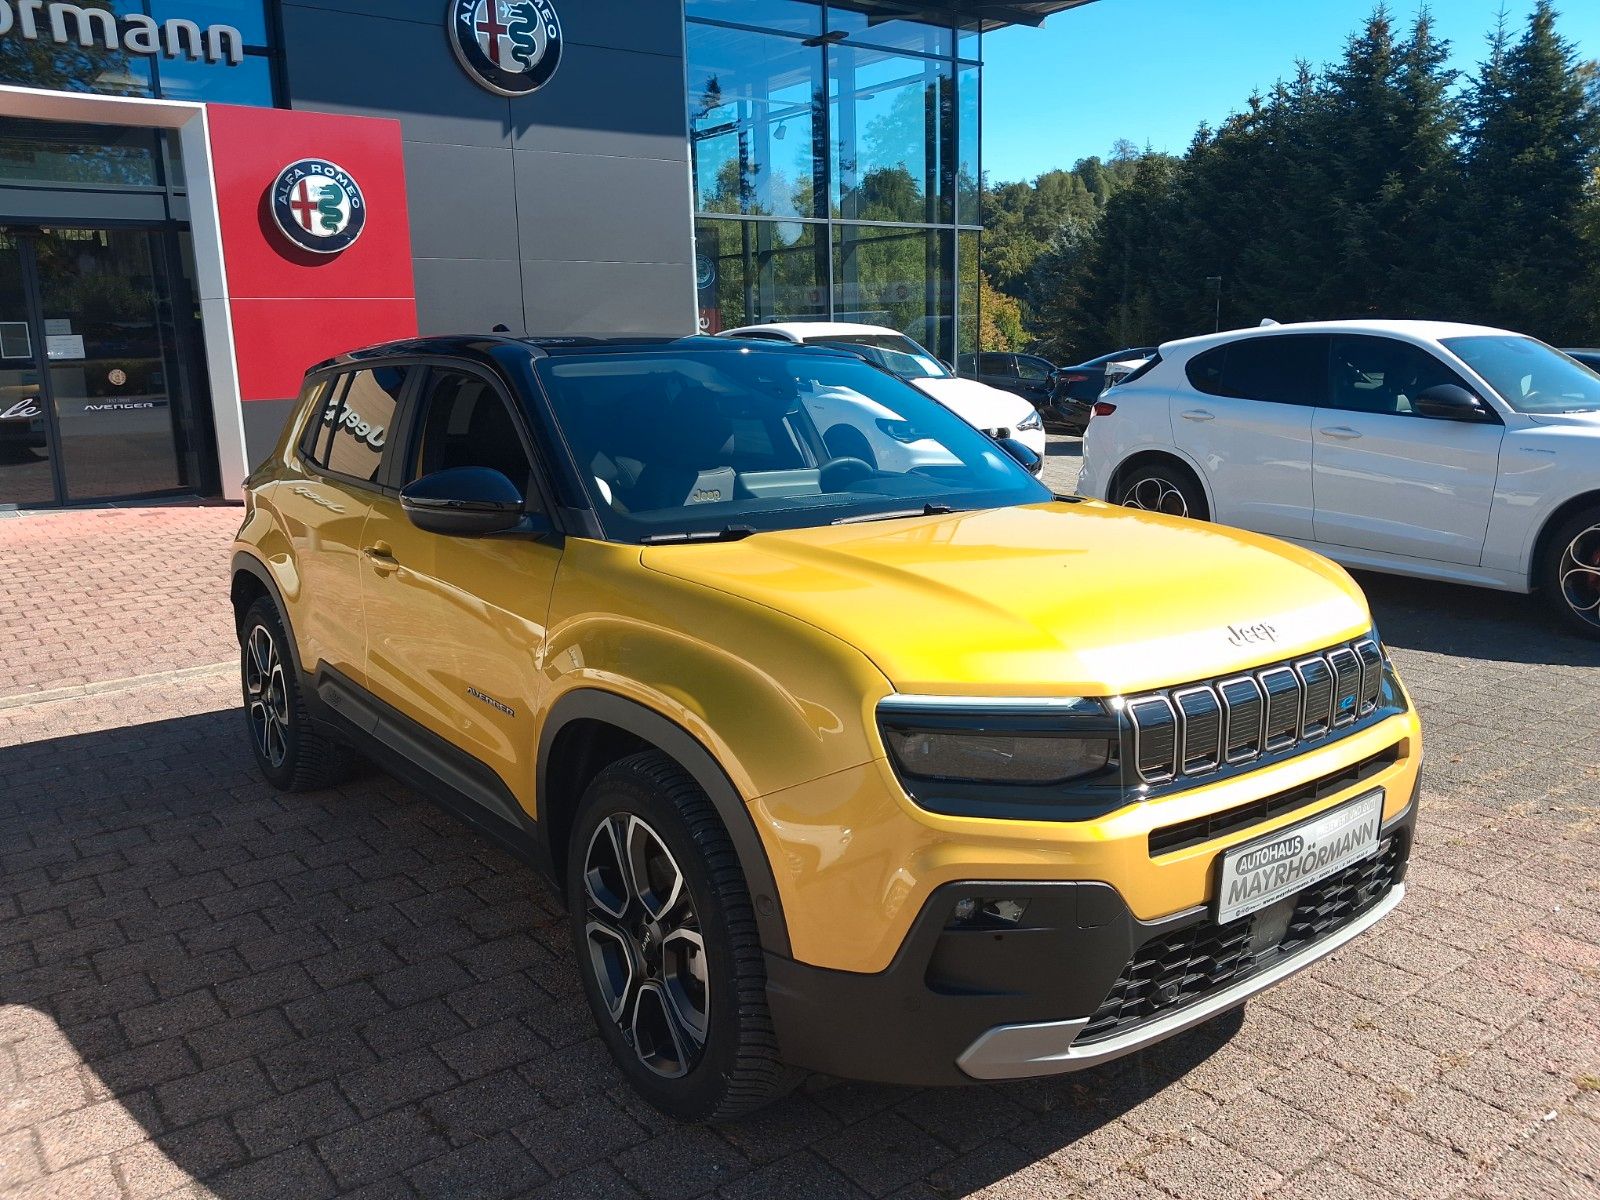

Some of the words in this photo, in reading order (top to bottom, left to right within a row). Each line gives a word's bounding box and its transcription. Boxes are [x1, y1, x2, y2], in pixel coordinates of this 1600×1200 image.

[278, 168, 305, 206] ALFA
[311, 164, 360, 209] ROMEO
[84, 402, 154, 411] AVENGER
[693, 488, 721, 503] Jeep
[1227, 623, 1276, 647] Jeep
[467, 686, 515, 718] AVENGER
[1227, 818, 1374, 906] MAYRHÖRMANN
[1239, 837, 1301, 873] AUTOHAUS
